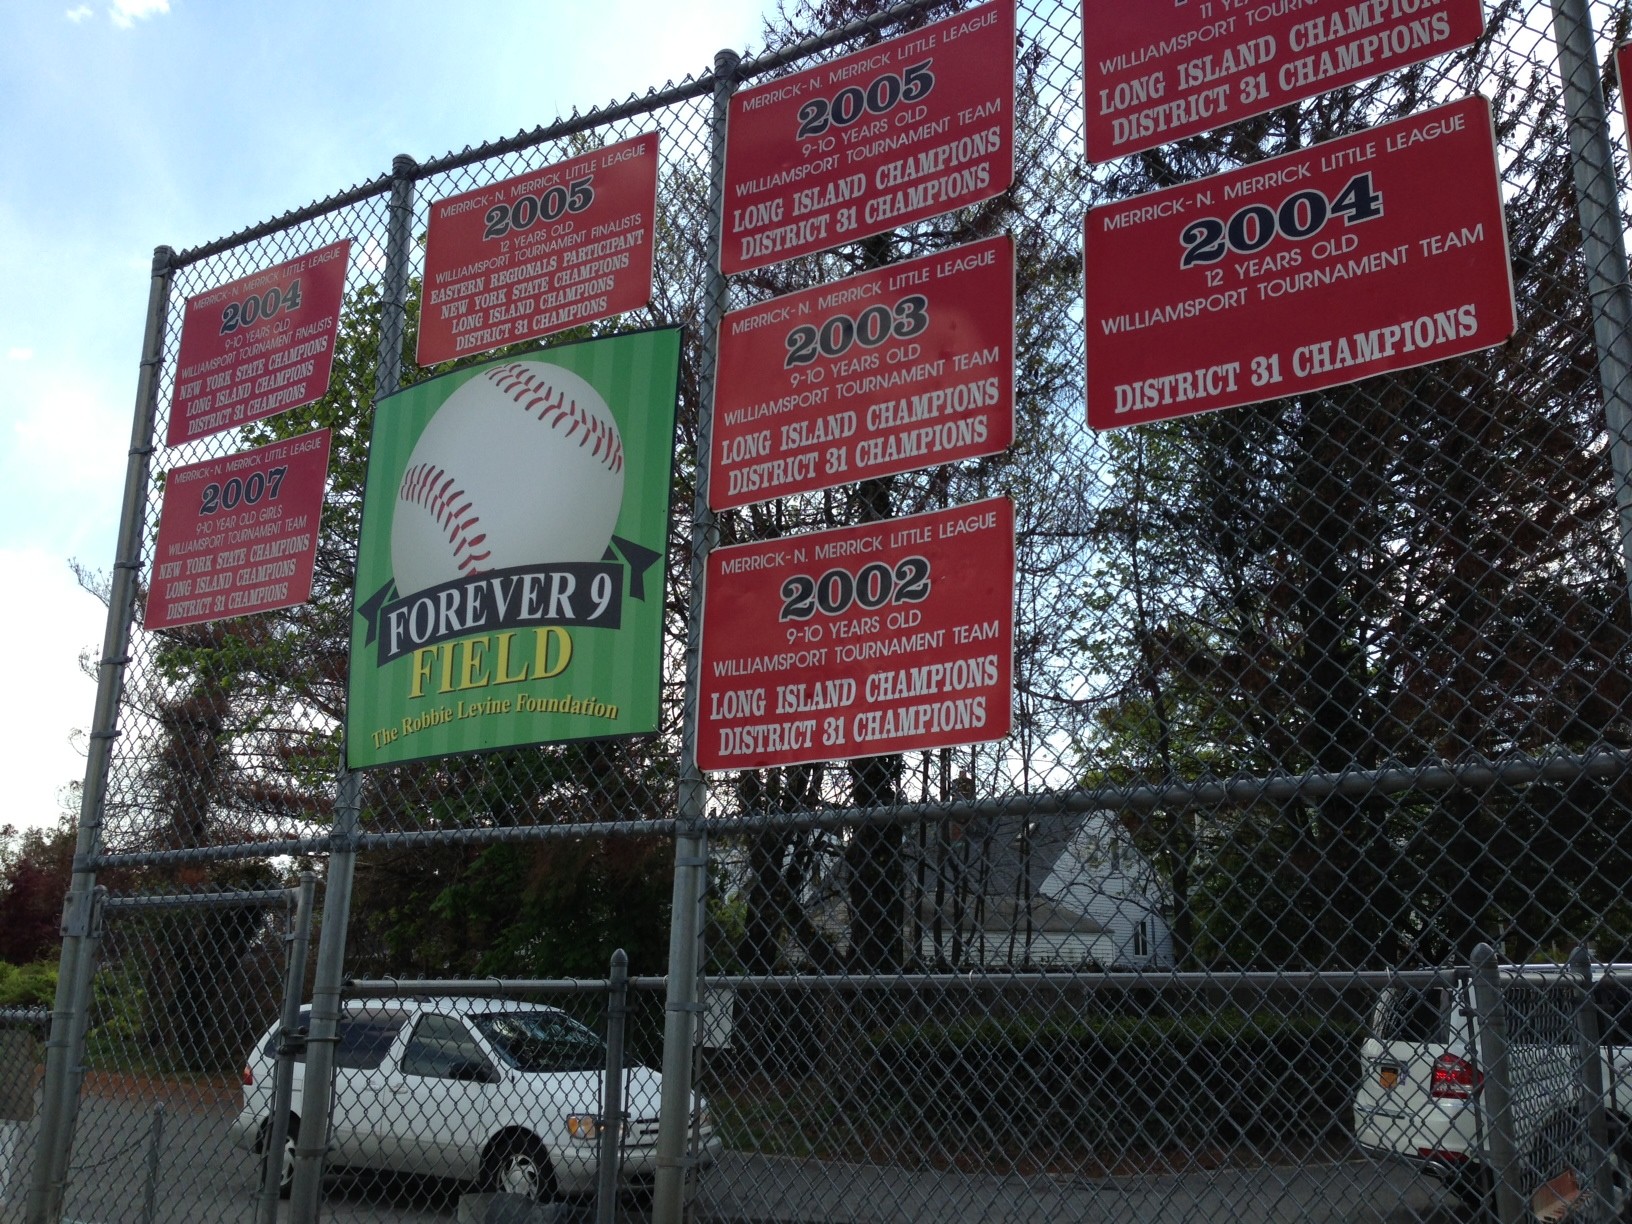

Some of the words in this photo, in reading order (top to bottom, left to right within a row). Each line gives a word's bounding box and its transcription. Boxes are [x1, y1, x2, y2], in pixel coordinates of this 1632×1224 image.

[830, 52, 890, 84] MERRICK
[898, 35, 936, 60] LITTLE
[944, 11, 997, 43] LEAGUE
[1100, 16, 1236, 75] WILLIAMSPORT
[1100, 72, 1165, 115] LONG
[1178, 35, 1276, 90] ISLAND
[796, 57, 935, 141] 2005
[1112, 84, 1229, 145] DISTRICT
[1240, 72, 1269, 104] 31
[1279, 11, 1450, 91] CHAMPIONS
[736, 154, 840, 197] WILLIAMSPORT
[847, 116, 950, 164] TOURNAMENT
[958, 98, 1001, 125] TEAM
[802, 137, 835, 157] 9-10
[842, 119, 888, 144] YEARS
[895, 105, 927, 126] OLD
[1225, 162, 1311, 200] MERRICK
[1322, 142, 1376, 172] LITTLE
[1387, 114, 1465, 152] LEAGUE
[511, 172, 560, 197] MERRICK
[566, 160, 596, 180] LITTLE
[602, 144, 645, 168] LEAGUE
[733, 198, 784, 233] LONG
[793, 173, 866, 216] ISLAND
[876, 126, 1000, 190] CHAMPIONS
[482, 174, 595, 242] 2005
[501, 240, 510, 252] 12
[514, 229, 546, 248] YEARS
[551, 221, 574, 236] OLD
[741, 214, 829, 260] DISTRICT
[836, 206, 858, 233] 31
[865, 162, 990, 224] CHAMPIONS
[1180, 171, 1384, 270] 2004
[243, 271, 279, 292] MERRICK
[283, 261, 306, 278] LITTLE
[309, 247, 340, 268] LEAGUE
[430, 277, 485, 305] EASTERN
[490, 256, 557, 288] REGIONALS
[563, 229, 644, 267] PARTICIPANT
[436, 254, 510, 284] WILLIAMSPORT
[515, 230, 587, 261] TOURNAMENT
[591, 213, 641, 239] FINALISTS
[1205, 269, 1223, 287] 12
[1235, 249, 1302, 279] YEARS
[1312, 234, 1358, 259] OLD
[219, 278, 302, 336] 2004
[441, 300, 469, 319] NEW
[474, 289, 506, 310] YORK
[512, 277, 549, 299] STATE
[555, 253, 629, 287] CHAMPIONS
[452, 313, 483, 334] LONG
[489, 299, 534, 323] ISLAND
[540, 276, 614, 309] CHAMPIONS
[819, 281, 881, 310] MERRICK
[890, 268, 929, 290] LITTLE
[937, 250, 995, 278] LEAGUE
[1101, 288, 1248, 335] WILLIAMSPORT
[1258, 245, 1409, 300] TOURNAMENT
[1419, 223, 1484, 257] TEAM
[182, 351, 237, 379] WILLIAMSPORT
[240, 331, 293, 360] TOURNAMENT
[296, 316, 332, 340] FINALISTS
[225, 335, 243, 351] 9-10
[246, 325, 270, 343] YEARS
[273, 318, 290, 333] OLD
[456, 323, 511, 351] DISTRICT
[515, 319, 528, 334] 31
[533, 296, 607, 330] CHAMPIONS
[784, 294, 930, 370] 2003
[179, 380, 202, 400] NEW
[206, 370, 232, 391] YORK
[236, 359, 265, 381] STATE
[269, 336, 328, 370] CHAMPIONS
[186, 396, 211, 417] LONG
[215, 383, 251, 407] ISLAND
[255, 360, 314, 394] CHAMPIONS
[724, 387, 829, 426] WILLIAMSPORT
[836, 360, 945, 399] TOURNAMENT
[953, 346, 999, 371] TEAM
[791, 367, 824, 388] 9-10
[831, 353, 879, 377] YEARS
[887, 344, 921, 364] OLD
[1114, 362, 1240, 414] DISTRICT
[1251, 354, 1283, 386] 31
[1293, 304, 1478, 377] CHAMPIONS
[187, 408, 232, 435] DISTRICT
[233, 404, 244, 420] 31
[247, 383, 306, 416] CHAMPIONS
[721, 430, 771, 465] LONG
[780, 411, 857, 450] ISLAND
[867, 377, 999, 431] CHAMPIONS
[226, 454, 262, 472] MERRICK
[265, 447, 287, 463] LITTLE
[290, 437, 322, 456] LEAGUE
[728, 452, 818, 496] DISTRICT
[826, 446, 847, 474] 31
[856, 415, 988, 467] CHAMPIONS
[196, 521, 213, 535] 9-10
[216, 515, 236, 530] YEAR
[239, 511, 256, 525] OLD
[259, 504, 282, 521] GIRLS
[198, 464, 288, 517] 2007
[158, 561, 182, 580] NEW
[186, 555, 213, 574] YORK
[216, 548, 247, 569] STATE
[250, 534, 310, 562] CHAMPIONS
[169, 534, 225, 556] WILLIAMSPORT
[228, 521, 282, 543] TOURNAMENT
[286, 515, 307, 531] TEAM
[816, 536, 882, 560] MERRICK
[891, 527, 931, 548] LITTLE
[940, 512, 996, 539] LEAGUE
[165, 580, 191, 599] LONG
[195, 572, 232, 593] ISLAND
[236, 559, 296, 586] CHAMPIONS
[166, 597, 212, 620] DISTRICT
[214, 595, 225, 612] 31
[228, 583, 288, 609] CHAMPIONS
[779, 555, 931, 623] 2002
[387, 572, 576, 657] FOREVER
[587, 572, 613, 621] 9
[787, 625, 823, 644] 9-10
[829, 616, 880, 638] YEARS
[887, 609, 921, 629] OLD
[408, 625, 573, 698] FIELD
[714, 649, 827, 677] WILLIAMSPORT
[835, 629, 946, 663] TOURNAMENT
[953, 620, 999, 644] TEAM
[710, 688, 766, 720] LONG
[776, 678, 856, 713] ISLAND
[866, 655, 998, 703] CHAMPIONS
[371, 730, 398, 750] The
[401, 707, 453, 737] Robbie
[457, 697, 511, 719] Levine
[516, 693, 619, 720] Foundation
[719, 720, 816, 756] DISTRICT
[823, 717, 845, 746] 31
[853, 696, 986, 742] CHAMPIONS
